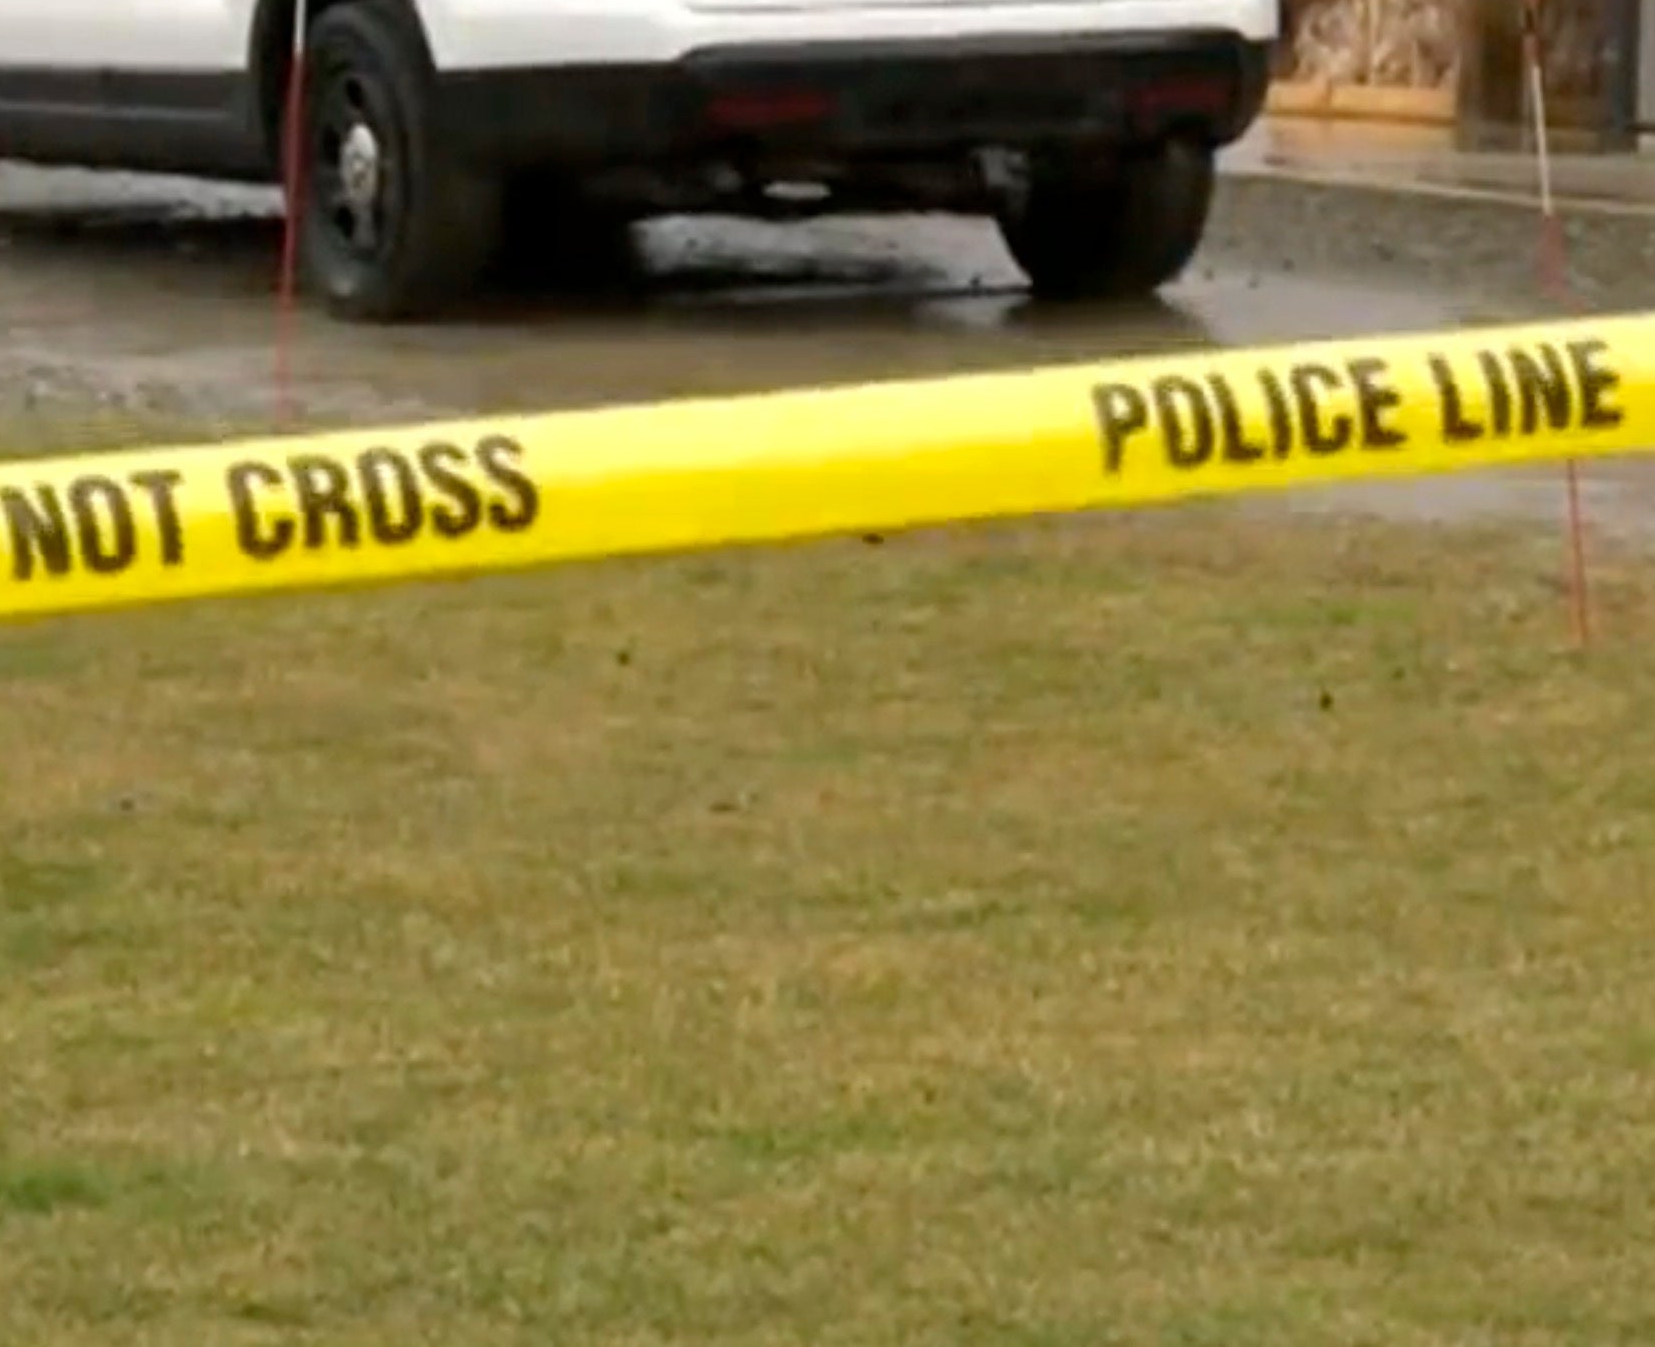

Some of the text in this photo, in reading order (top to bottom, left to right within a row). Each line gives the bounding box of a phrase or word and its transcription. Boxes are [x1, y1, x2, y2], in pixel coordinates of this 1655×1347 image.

[1091, 356, 1408, 476] POLICE
[1427, 338, 1624, 444] LINE
[225, 433, 541, 562] CROSS
